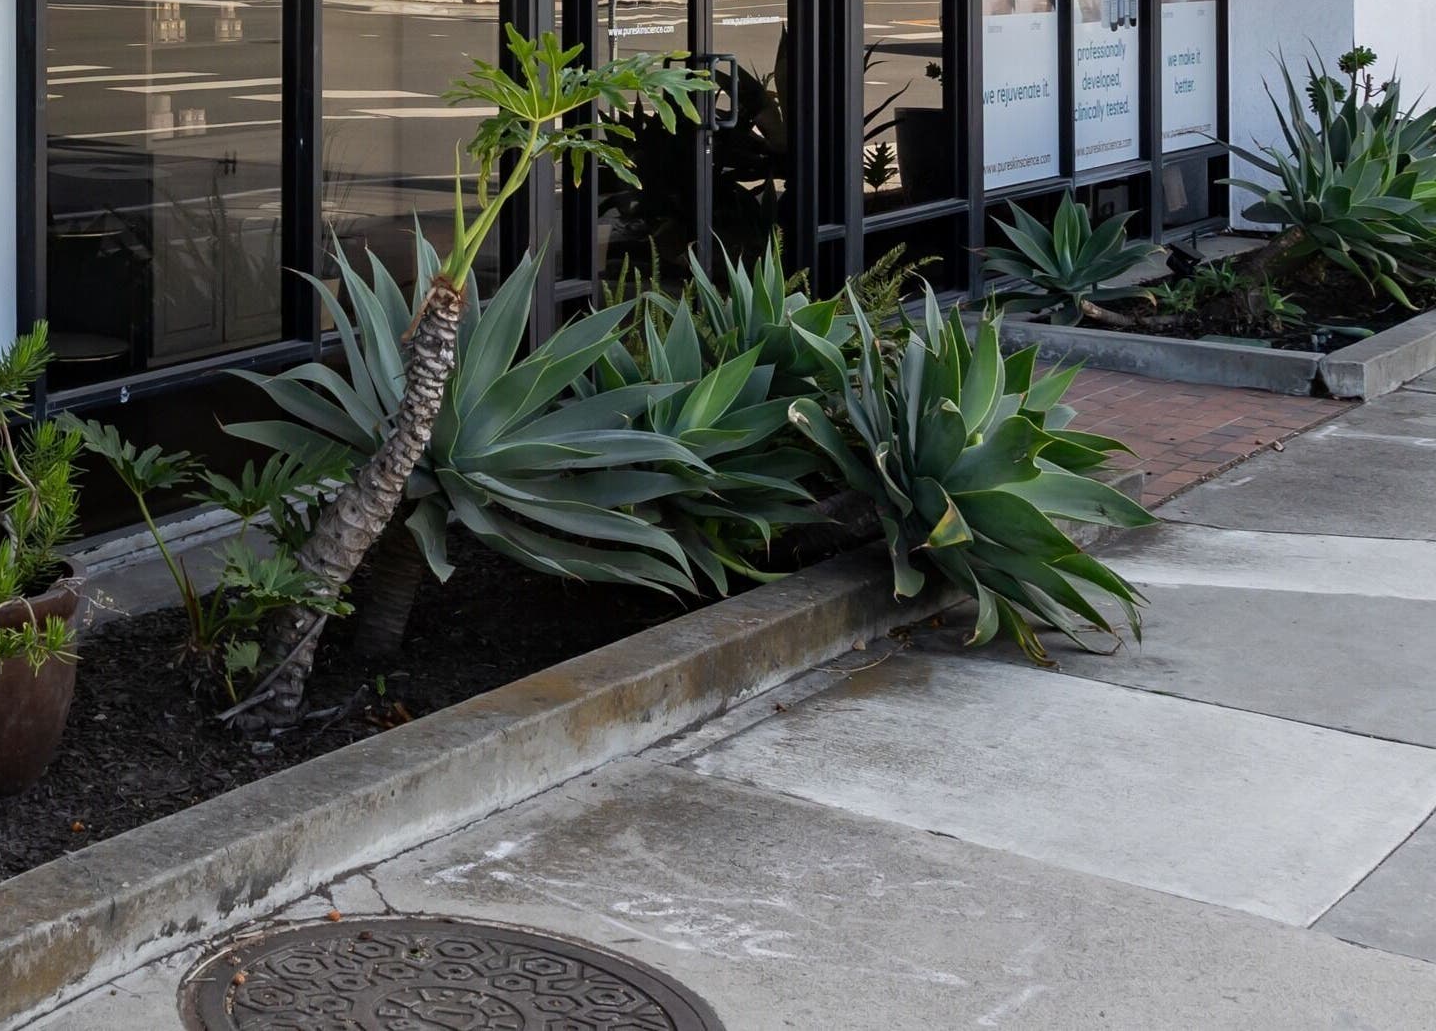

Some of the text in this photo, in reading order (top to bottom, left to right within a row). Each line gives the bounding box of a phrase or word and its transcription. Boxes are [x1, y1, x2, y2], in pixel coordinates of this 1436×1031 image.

[1077, 38, 1127, 67] professionally
[1167, 54, 1178, 67] we
[1178, 49, 1195, 66] make
[983, 88, 995, 105] we
[997, 81, 1041, 107] rejuvenate
